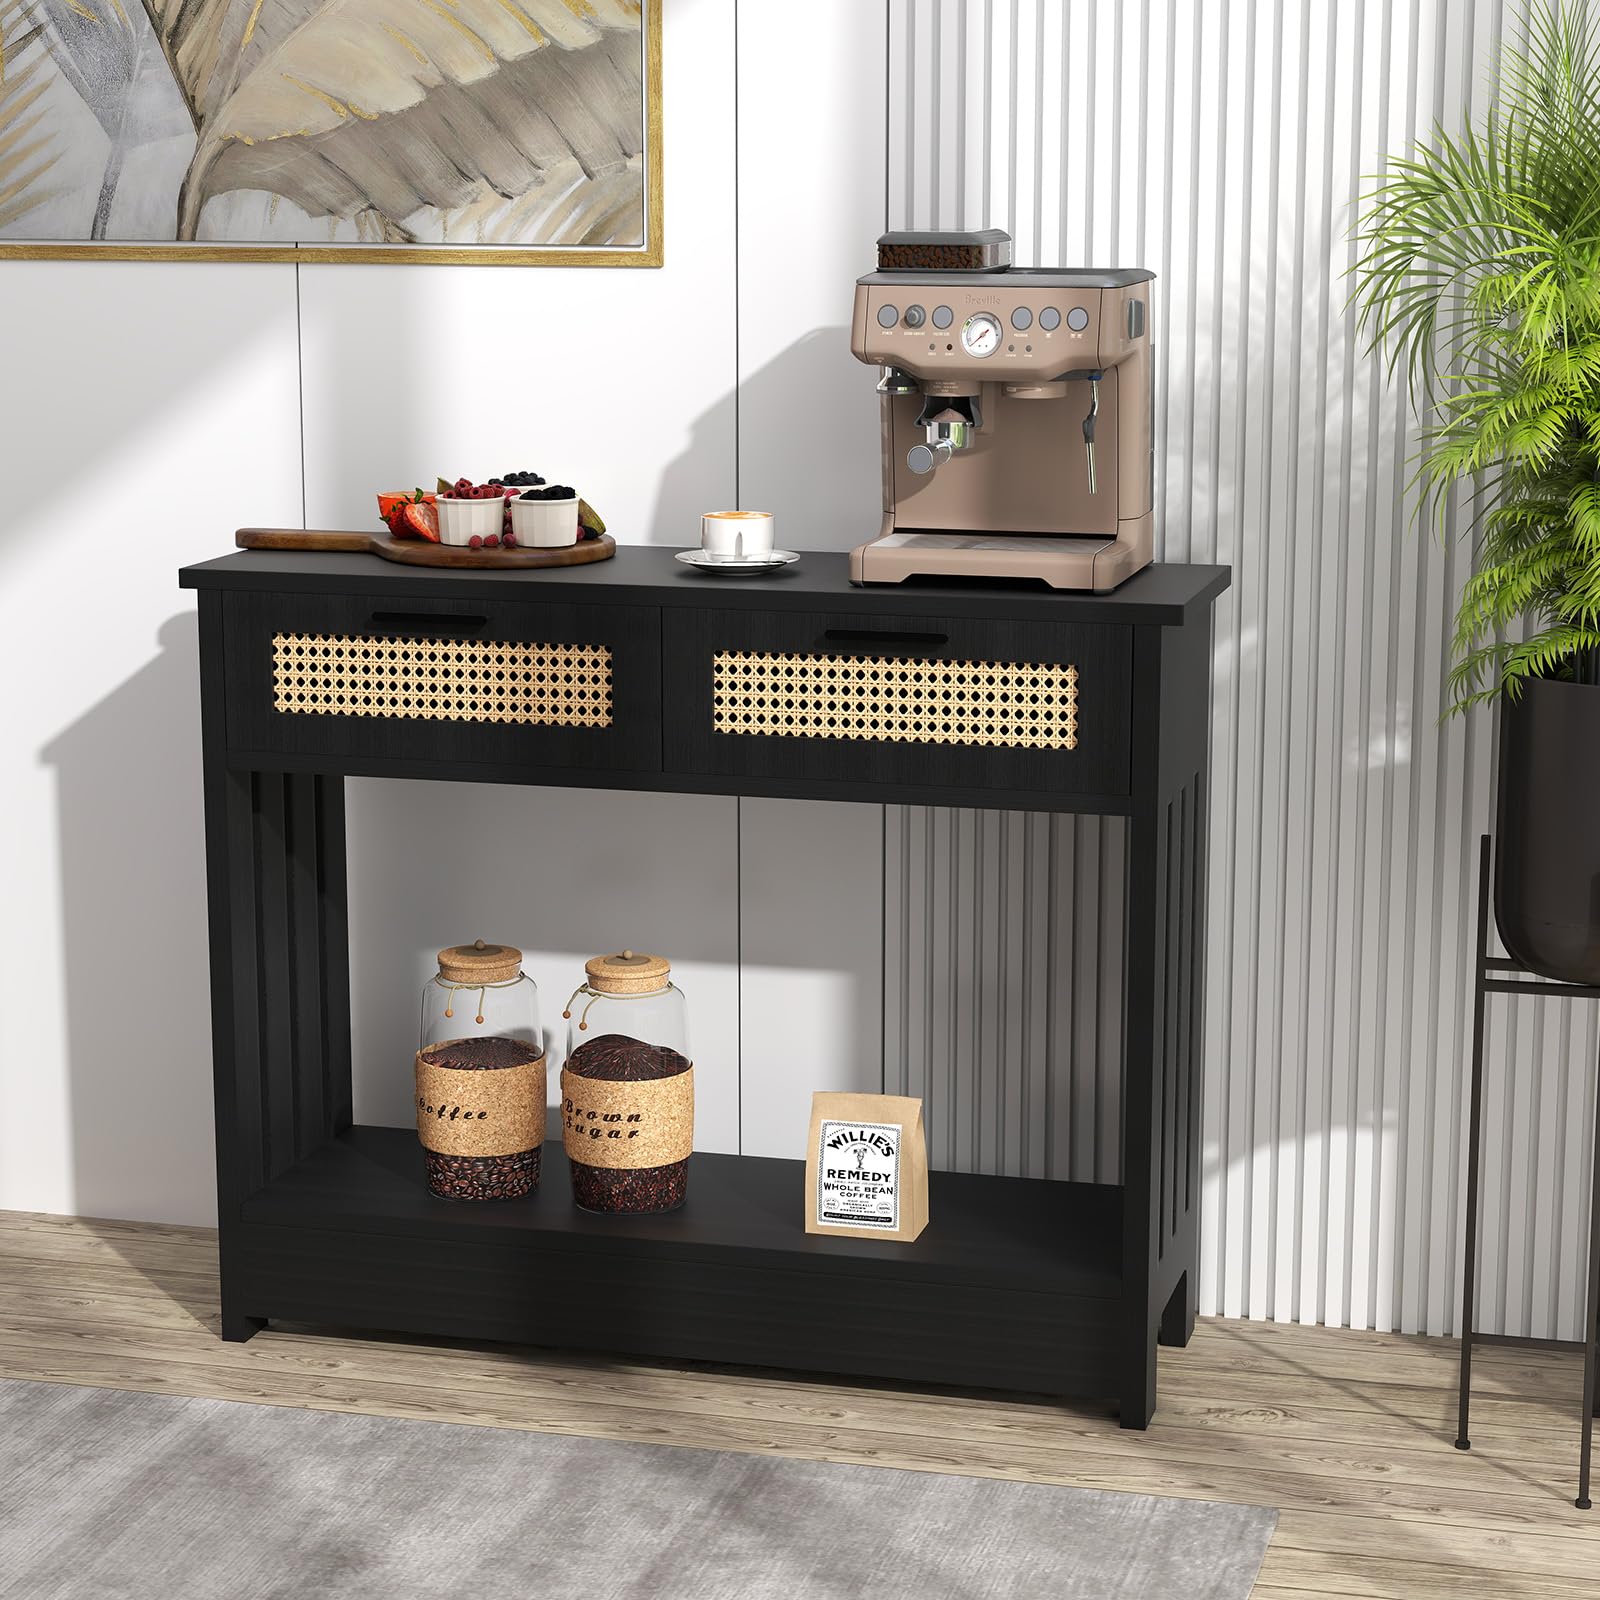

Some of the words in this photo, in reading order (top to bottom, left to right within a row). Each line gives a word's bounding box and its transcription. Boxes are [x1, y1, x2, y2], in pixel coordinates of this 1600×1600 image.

[965, 294, 1001, 305] Breville
[565, 1098, 642, 1122] Brown
[566, 1115, 640, 1139] Sugar
[826, 1130, 895, 1157] WILLIE'S
[827, 1169, 891, 1182] REMEDY
[823, 1182, 861, 1192] WHOLE
[864, 1186, 894, 1195] BEAN
[839, 1191, 877, 1200] COFFEE
